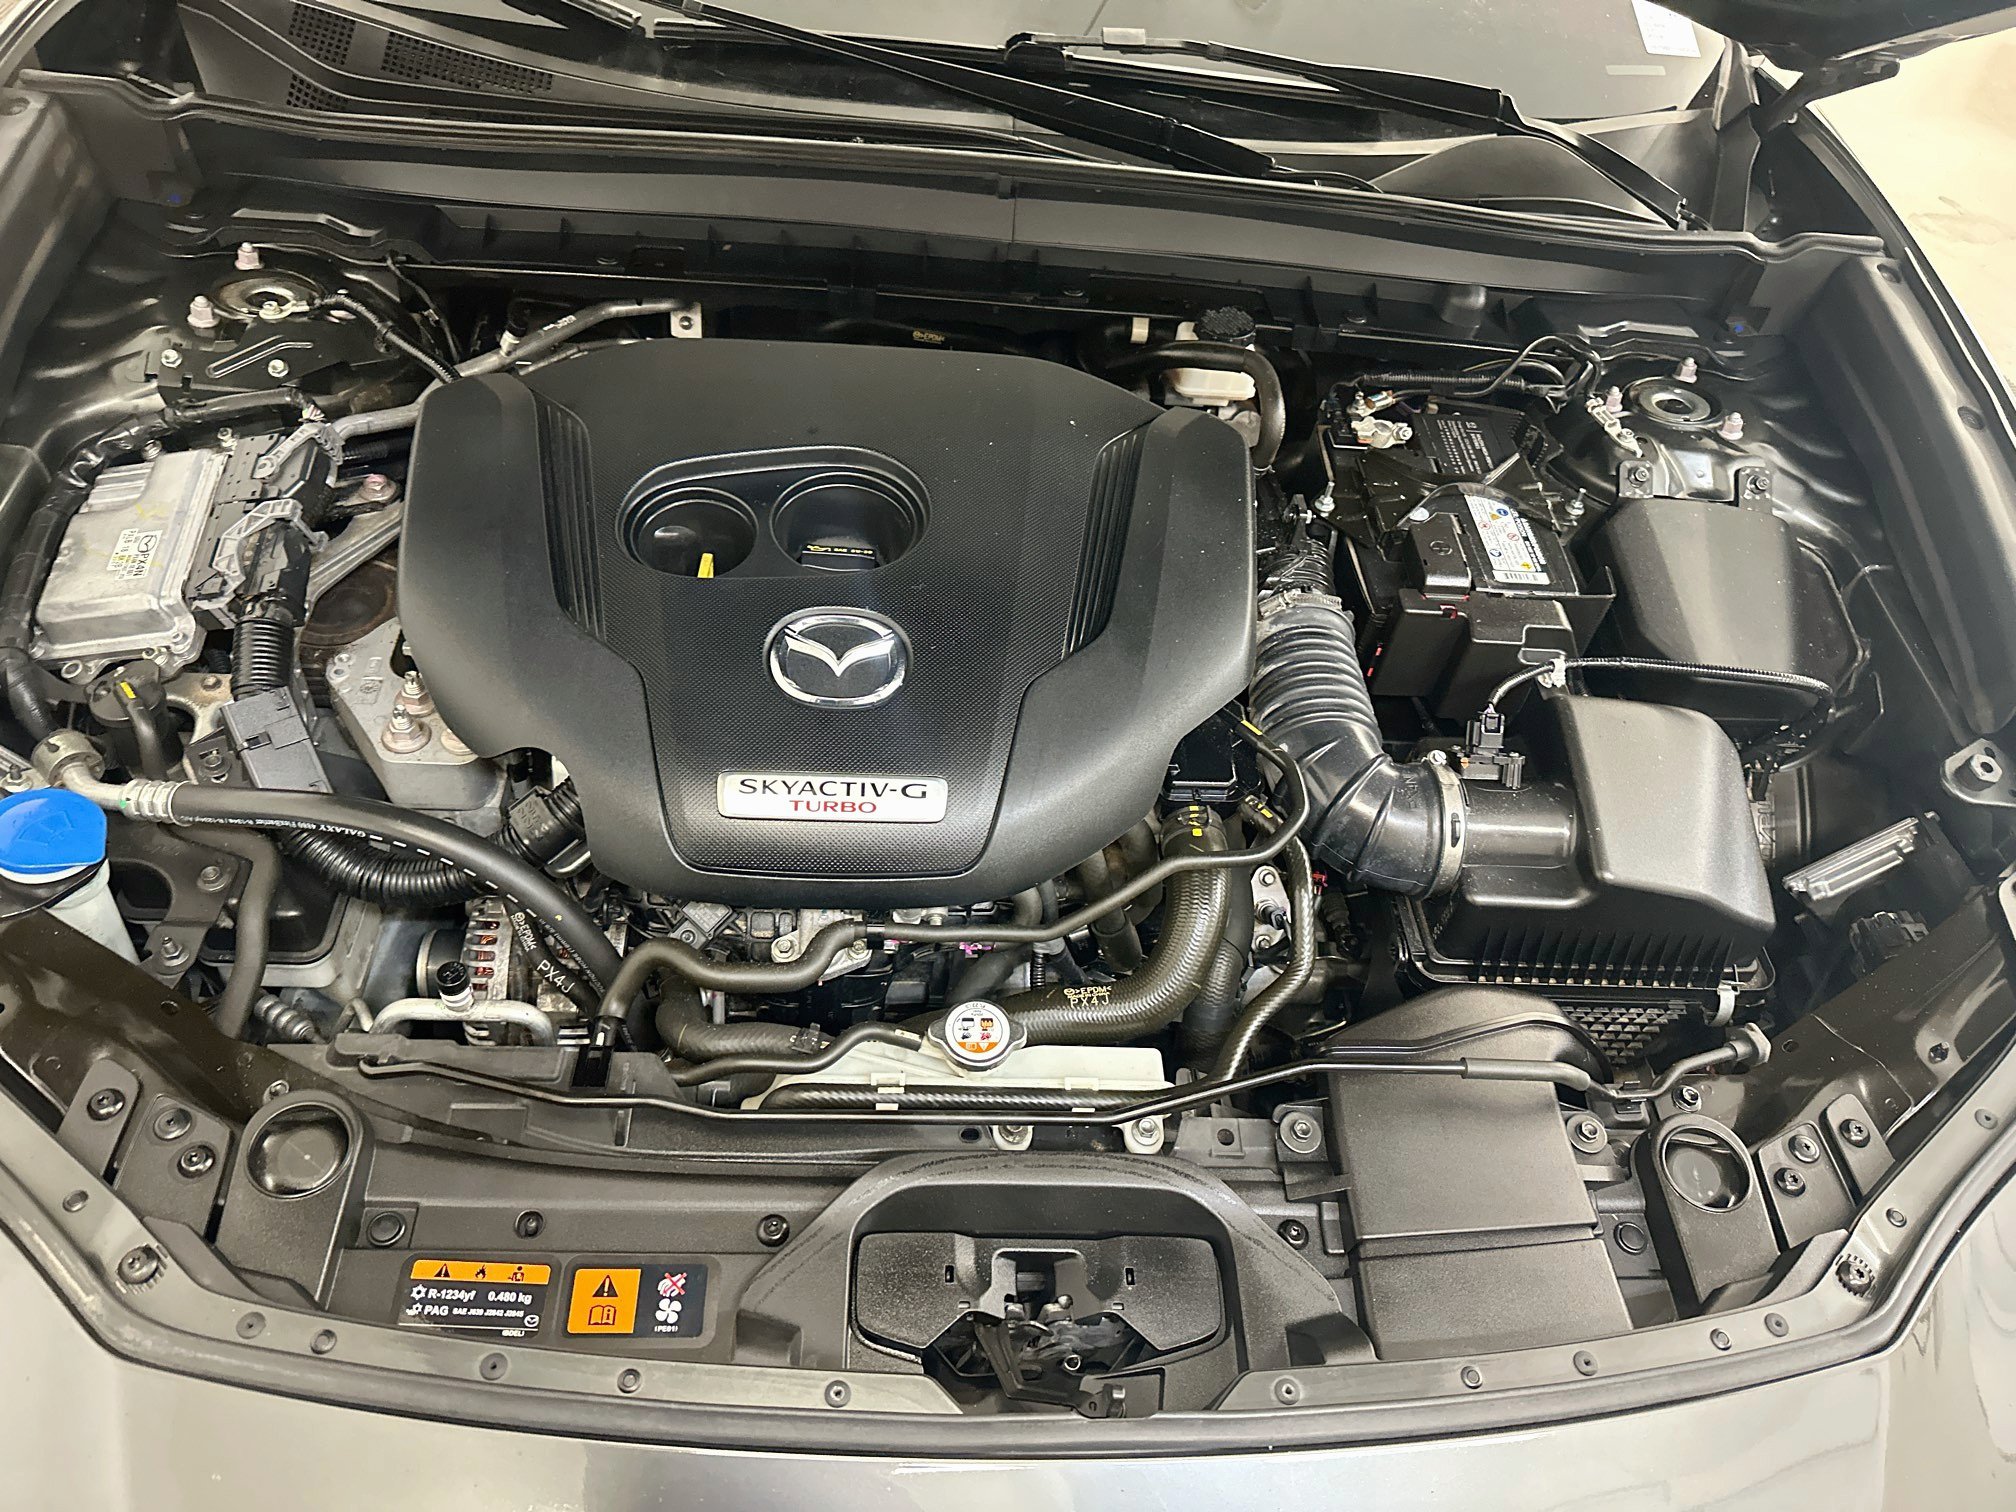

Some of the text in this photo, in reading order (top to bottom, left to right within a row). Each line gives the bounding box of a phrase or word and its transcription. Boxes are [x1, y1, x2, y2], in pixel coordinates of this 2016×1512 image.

[133, 553, 150, 576] PX4N
[738, 777, 928, 799] SKYACTIV-G
[789, 799, 877, 814] TURBO
[319, 824, 367, 838] GALAXY
[536, 959, 576, 993] PX4J
[1070, 993, 1109, 1009] PX4J
[427, 1288, 533, 1305] R-1234yf 0.480 kg
[424, 1304, 450, 1317] PAG
